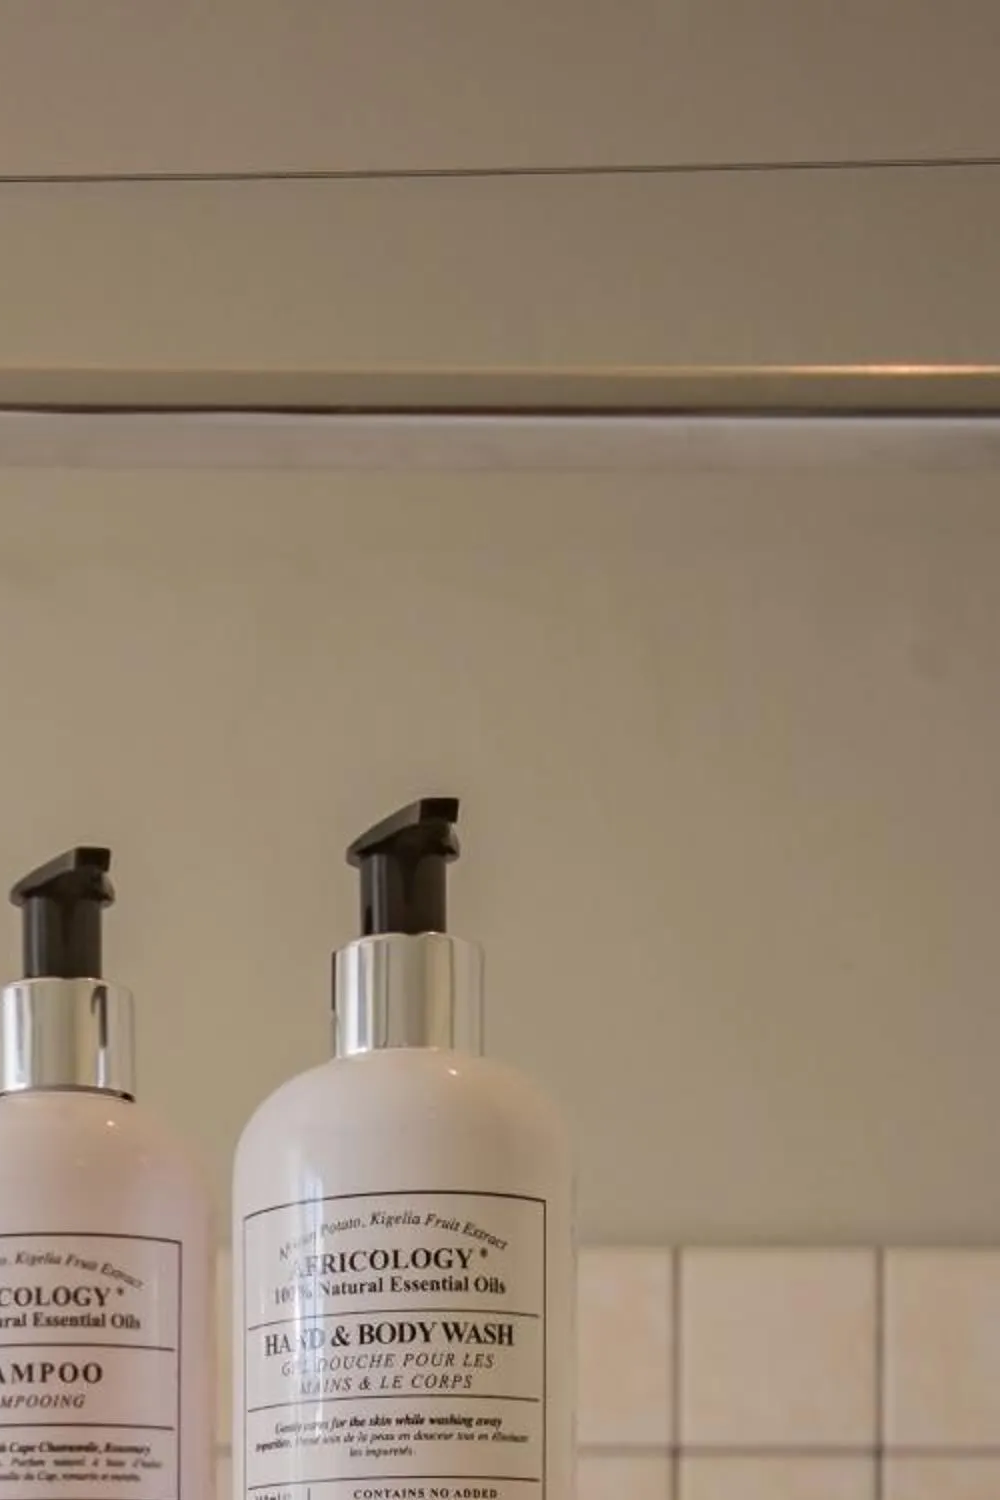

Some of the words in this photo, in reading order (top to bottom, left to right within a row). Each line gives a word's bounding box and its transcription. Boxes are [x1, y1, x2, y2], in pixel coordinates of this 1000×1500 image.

[370, 1211, 421, 1228] Kigelia
[424, 1213, 460, 1232] Fruit
[462, 1223, 509, 1251] Extract
[289, 1248, 473, 1279] FRICOLOGY
[320, 1278, 384, 1298] Natural
[390, 1275, 470, 1293] Essential
[473, 1276, 507, 1295] Oils
[33, 1311, 108, 1328] Essential
[110, 1313, 142, 1330] Oils
[330, 1324, 351, 1347] &
[358, 1322, 440, 1346] BODY
[440, 1321, 516, 1347] WASH
[315, 1353, 395, 1373] DOUCHE
[402, 1352, 455, 1368] POUR
[462, 1352, 495, 1369] LES
[358, 1375, 372, 1391] &
[379, 1374, 404, 1390] LE
[411, 1373, 474, 1390] CORPS
[353, 1487, 426, 1500] CONTAINS
[429, 1488, 450, 1499] NO
[453, 1488, 499, 1500] ADDED
